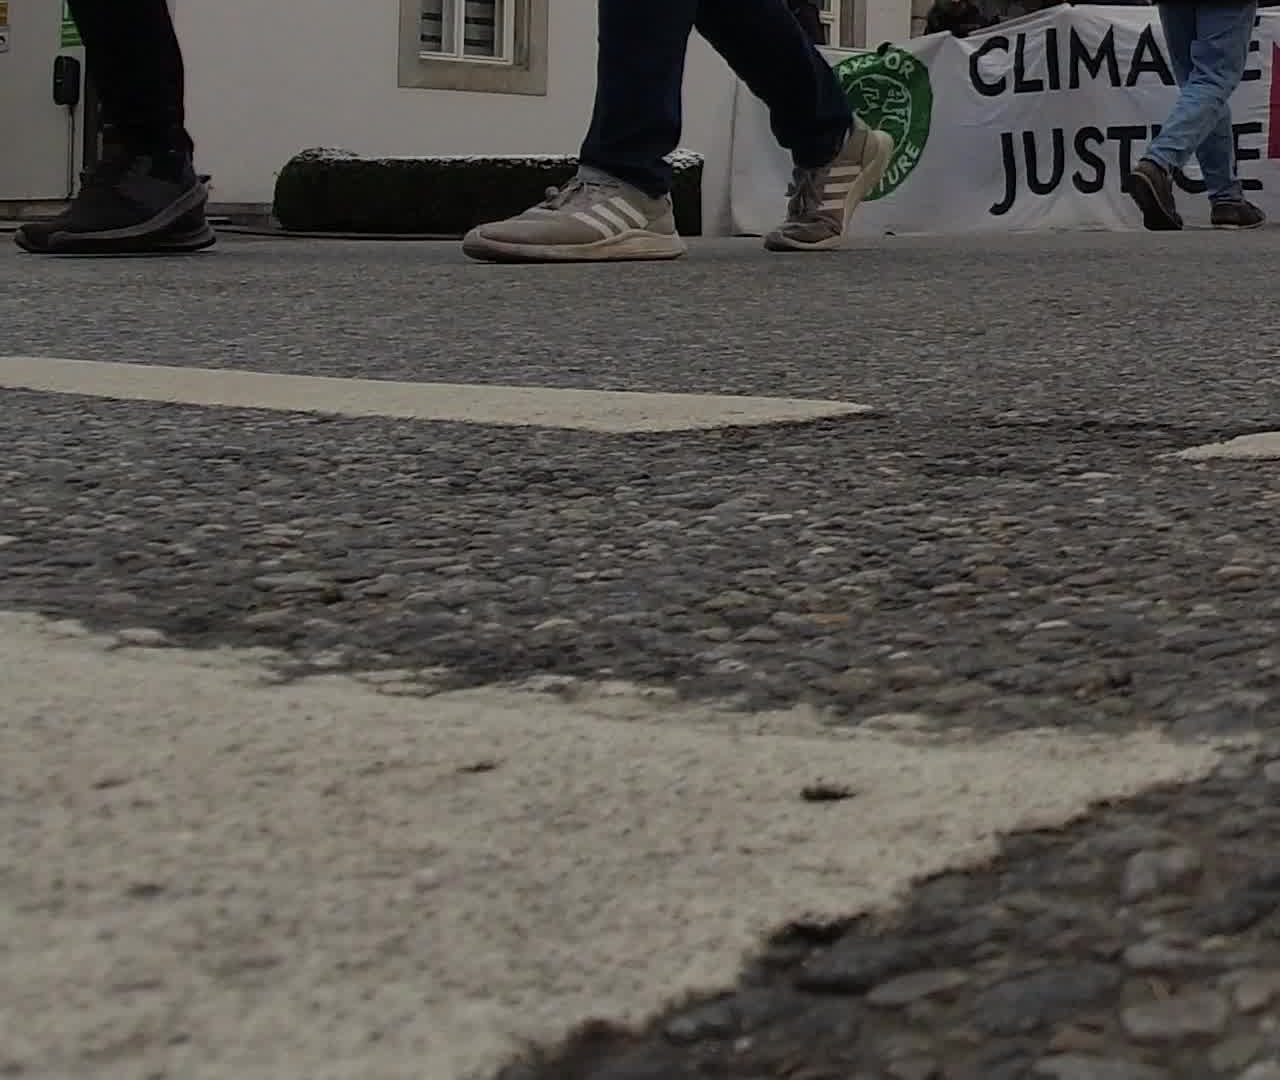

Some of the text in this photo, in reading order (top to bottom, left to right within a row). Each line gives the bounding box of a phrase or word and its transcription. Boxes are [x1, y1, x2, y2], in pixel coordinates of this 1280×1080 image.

[882, 52, 915, 80] OR
[968, 15, 1262, 97] CLIMAE
[988, 121, 1263, 216] JUSTE
